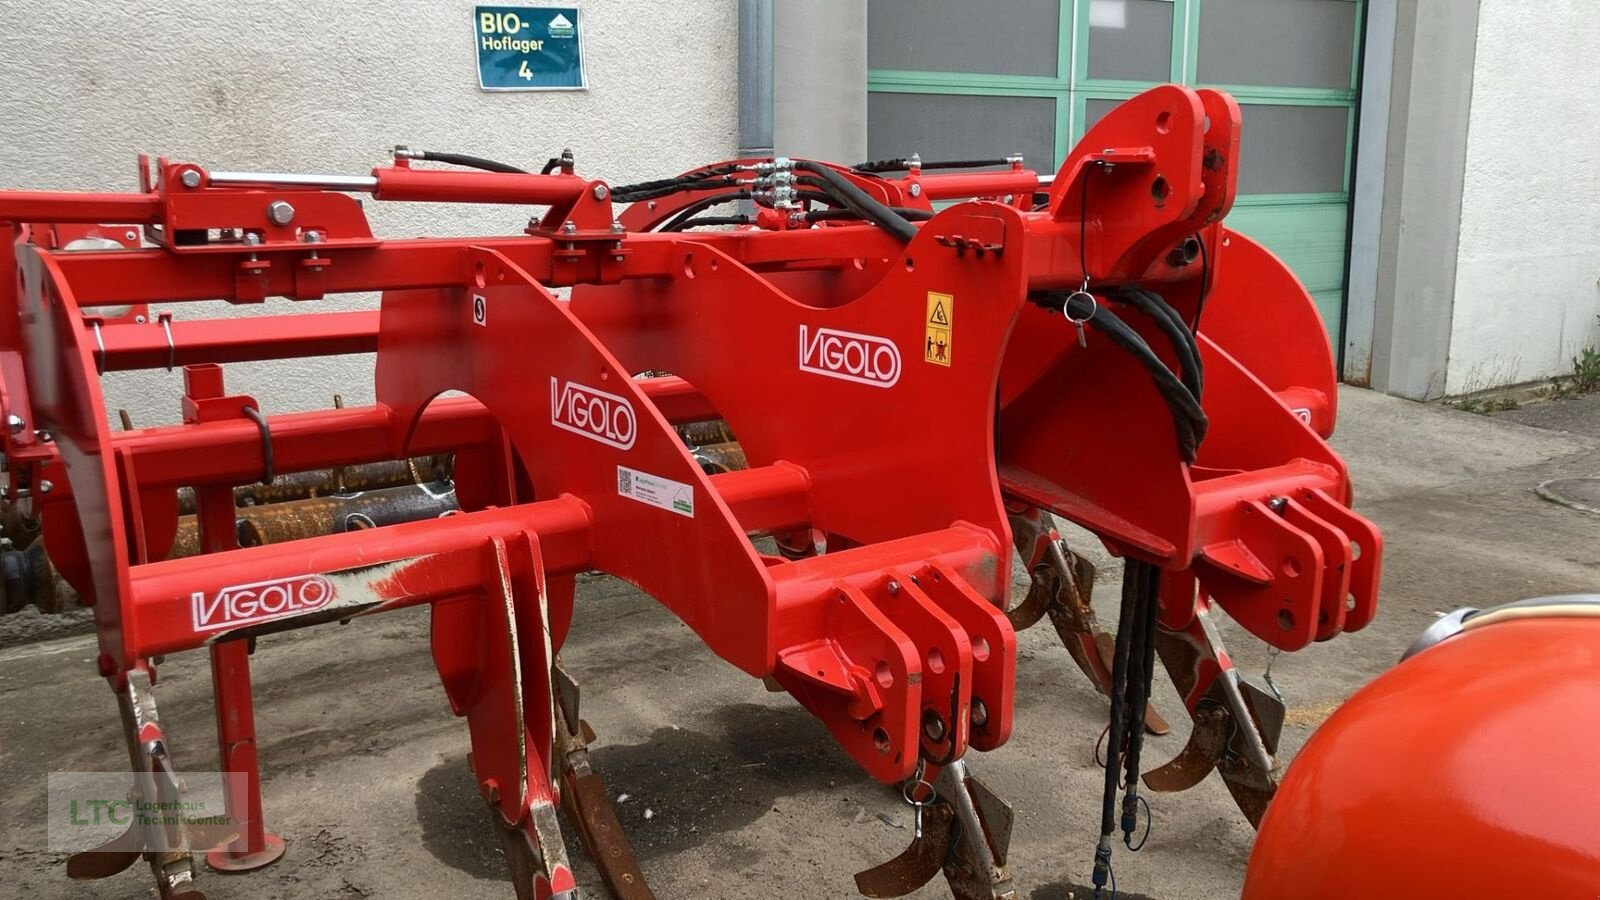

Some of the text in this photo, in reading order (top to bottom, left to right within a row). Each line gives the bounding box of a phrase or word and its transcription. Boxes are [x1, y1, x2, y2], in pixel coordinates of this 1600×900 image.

[480, 12, 530, 34] BIO-
[482, 36, 544, 54] Hoflager
[518, 60, 533, 81] 4
[799, 324, 902, 388] VIGOLO
[550, 375, 637, 451] VIGOLO
[191, 573, 333, 632] VIGOLO
